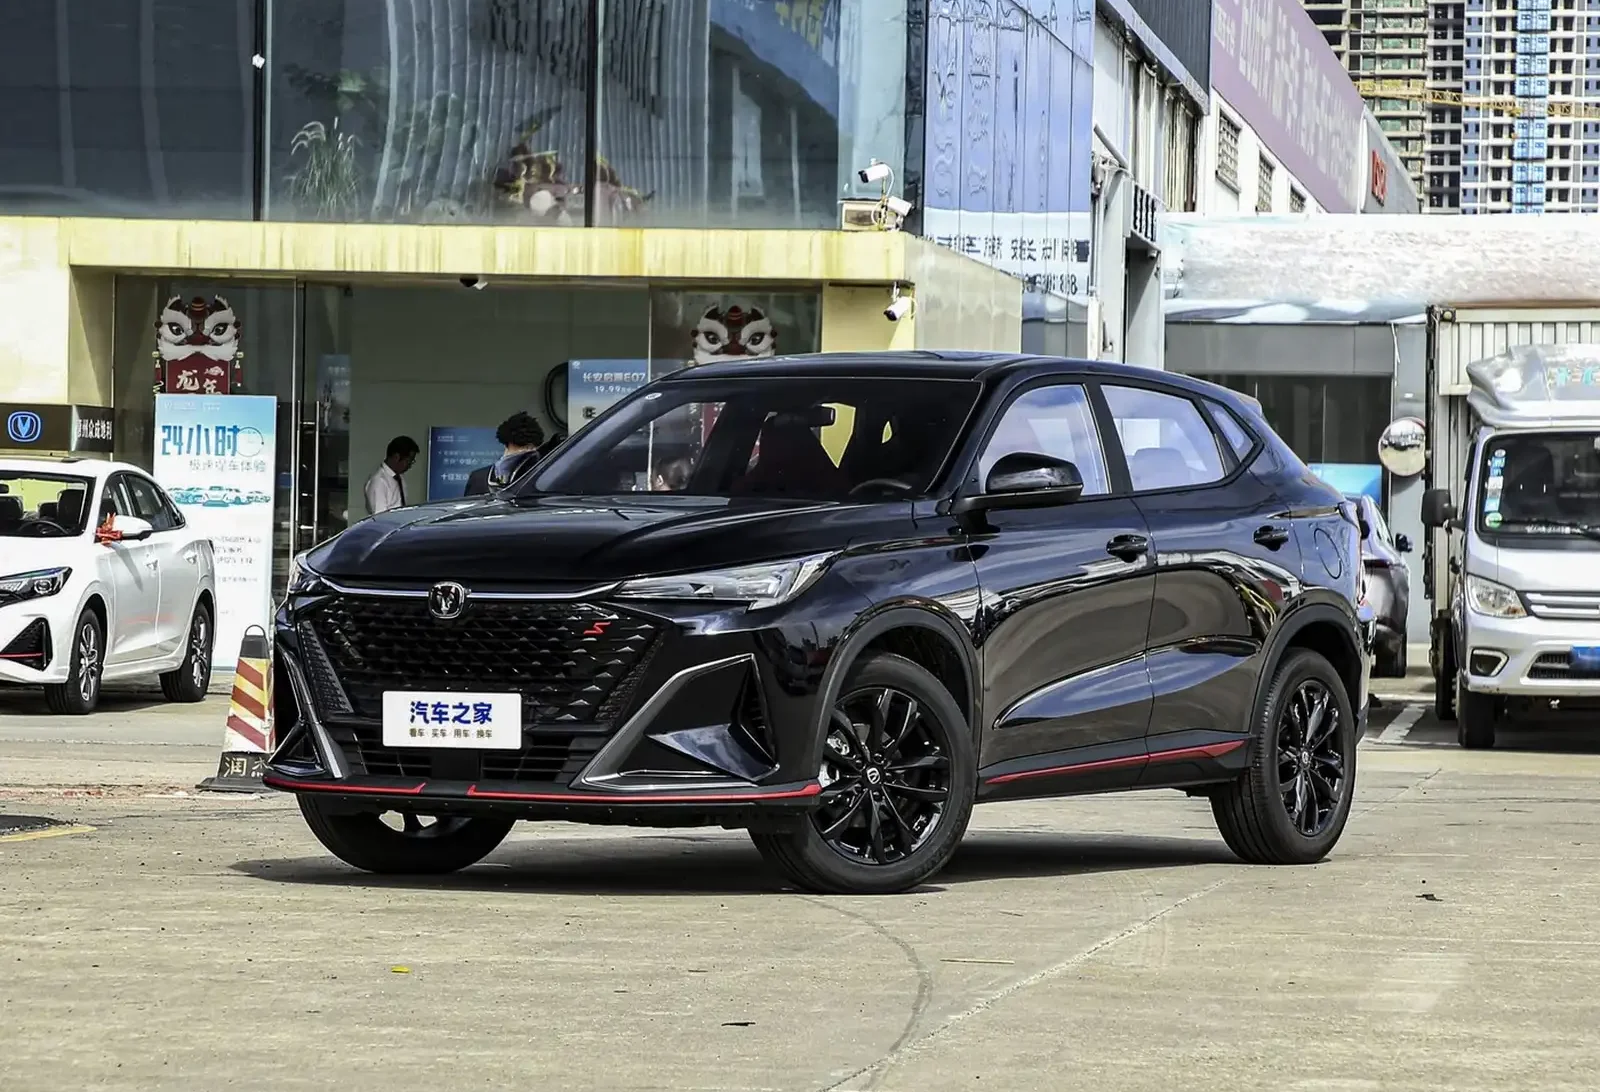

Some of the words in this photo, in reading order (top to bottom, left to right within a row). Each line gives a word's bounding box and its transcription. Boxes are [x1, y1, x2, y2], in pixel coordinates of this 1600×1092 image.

[161, 424, 241, 457] 24小时
[409, 700, 493, 725] 汽车之家
